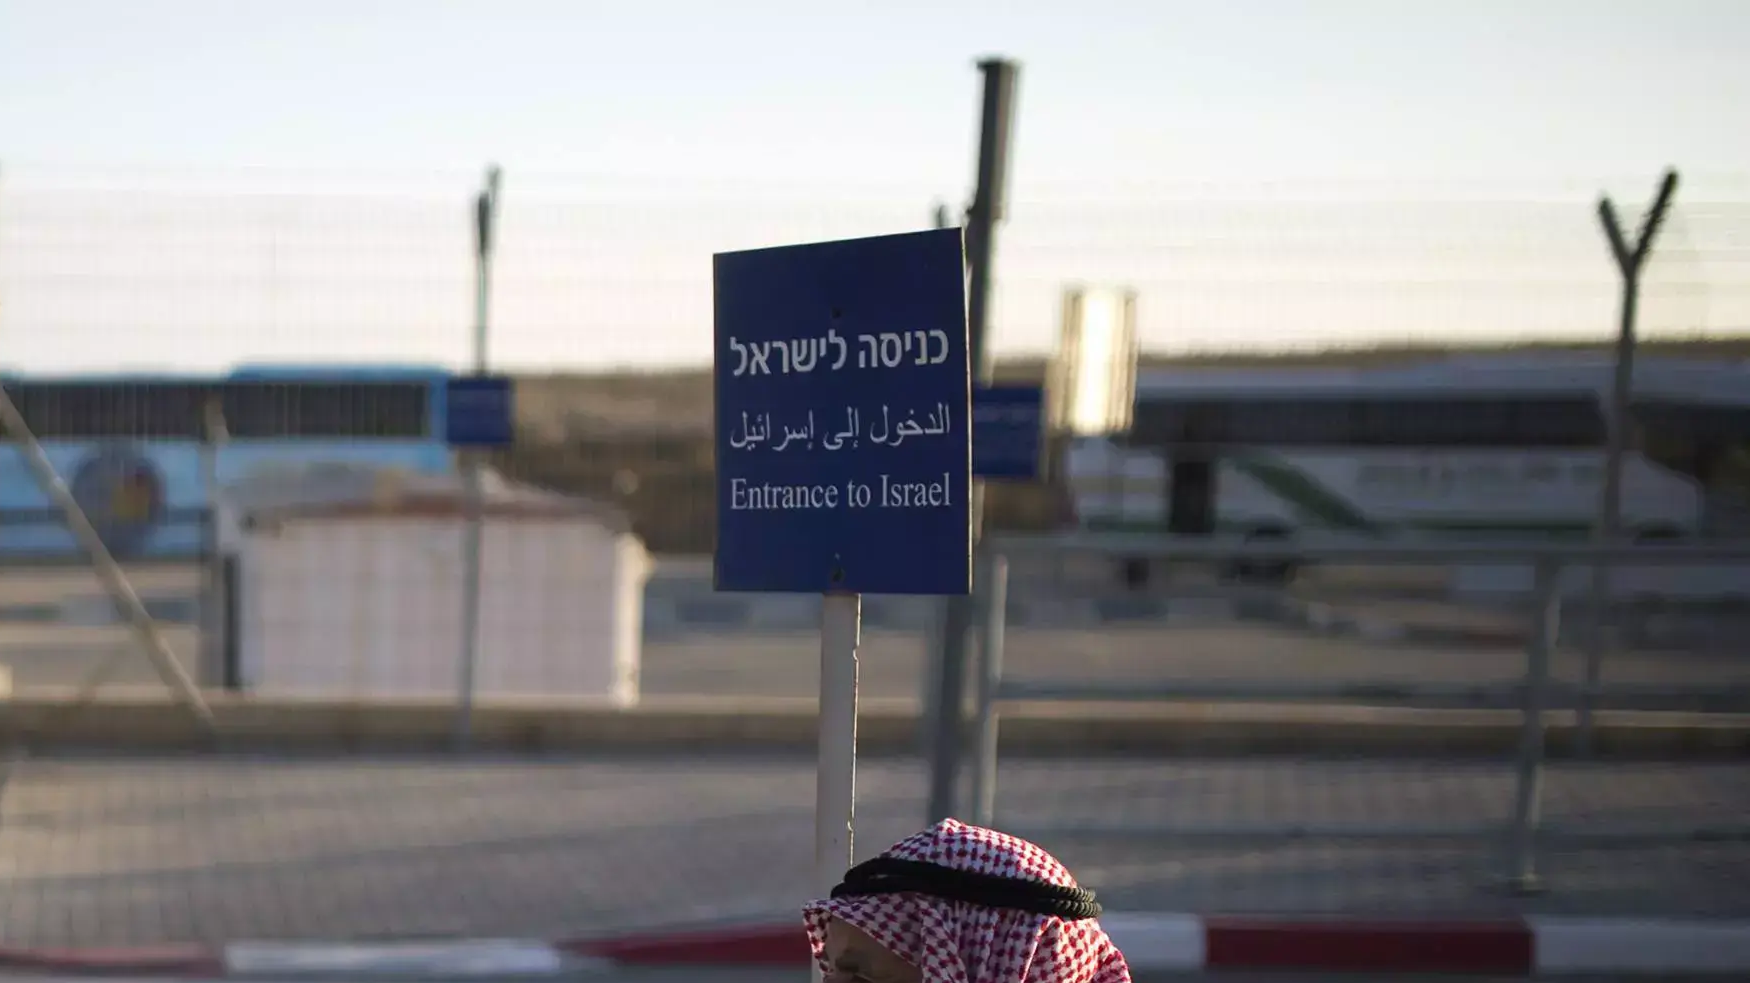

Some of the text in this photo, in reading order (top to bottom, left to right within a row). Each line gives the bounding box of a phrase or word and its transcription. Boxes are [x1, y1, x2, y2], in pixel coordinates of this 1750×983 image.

[729, 328, 949, 377] כניסה לישראל
[729, 409, 814, 452] إسرائيل
[822, 407, 860, 451] إلى
[870, 402, 951, 447] الدخول
[730, 472, 952, 510] Entrance to Israel
